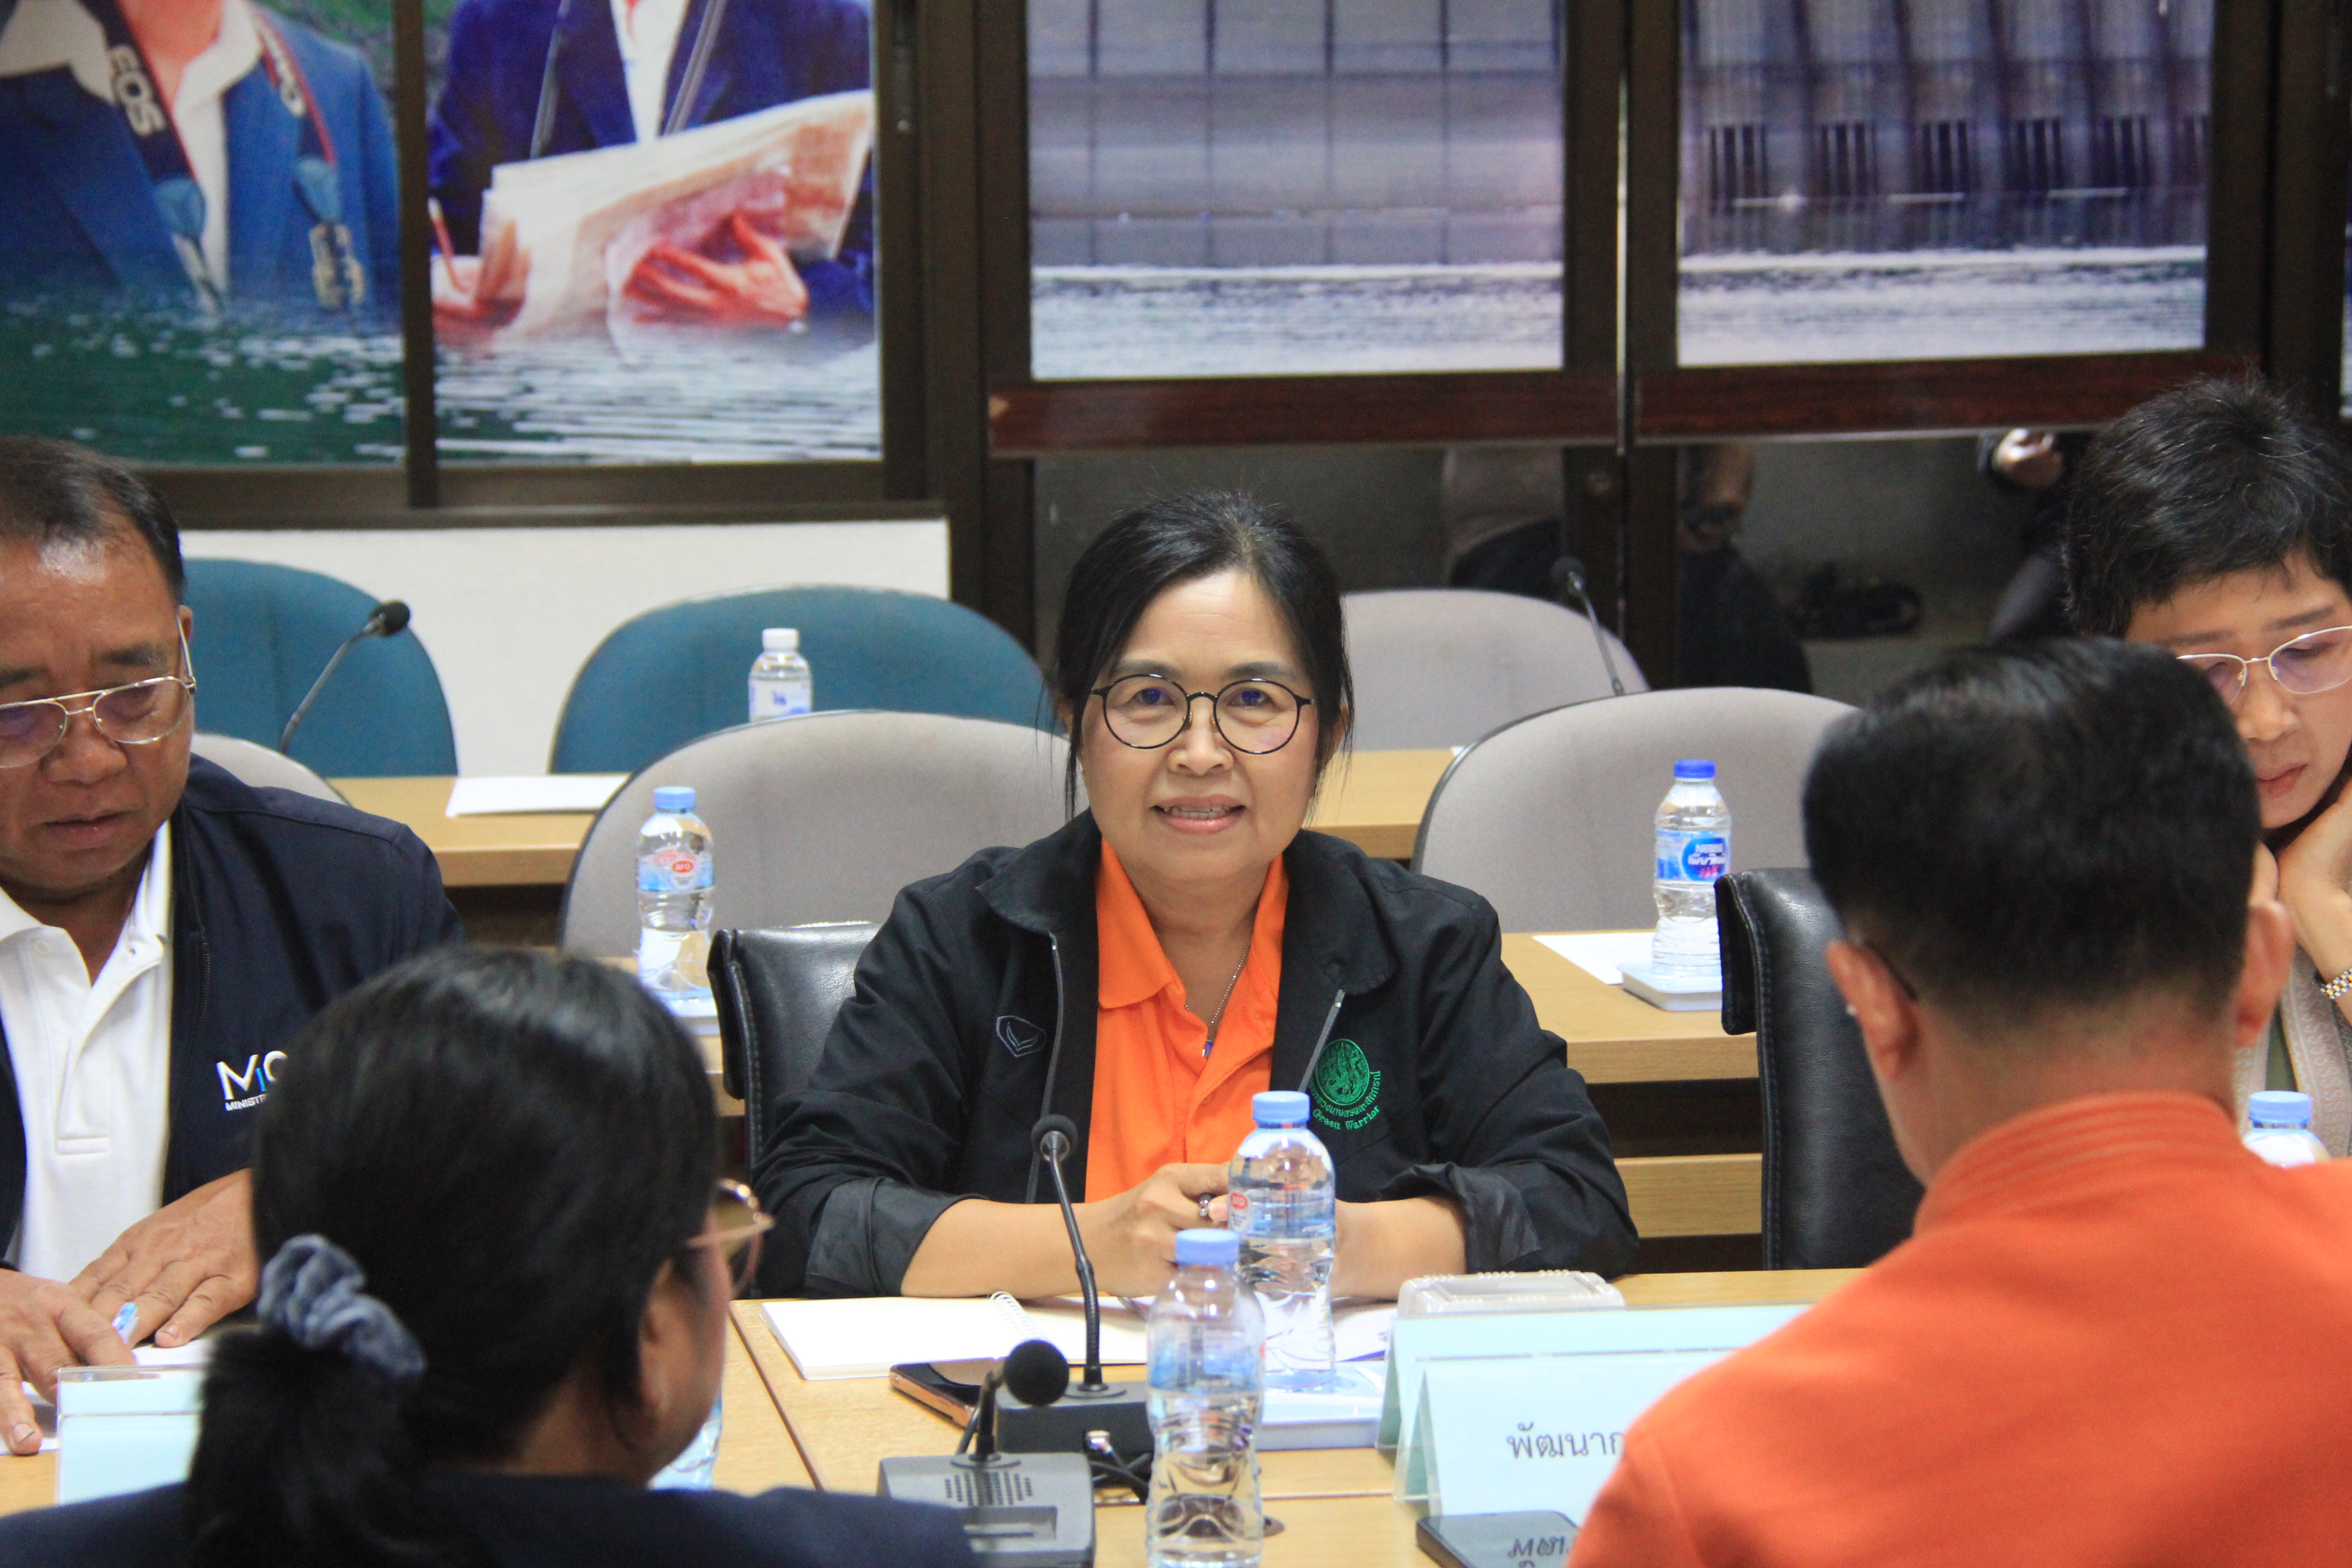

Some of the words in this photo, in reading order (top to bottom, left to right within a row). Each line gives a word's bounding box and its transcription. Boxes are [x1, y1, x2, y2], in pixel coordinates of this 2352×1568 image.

[108, 44, 166, 137] EOS
[1312, 1108, 1341, 1130] Green
[1345, 1105, 1381, 1130] Warrior
